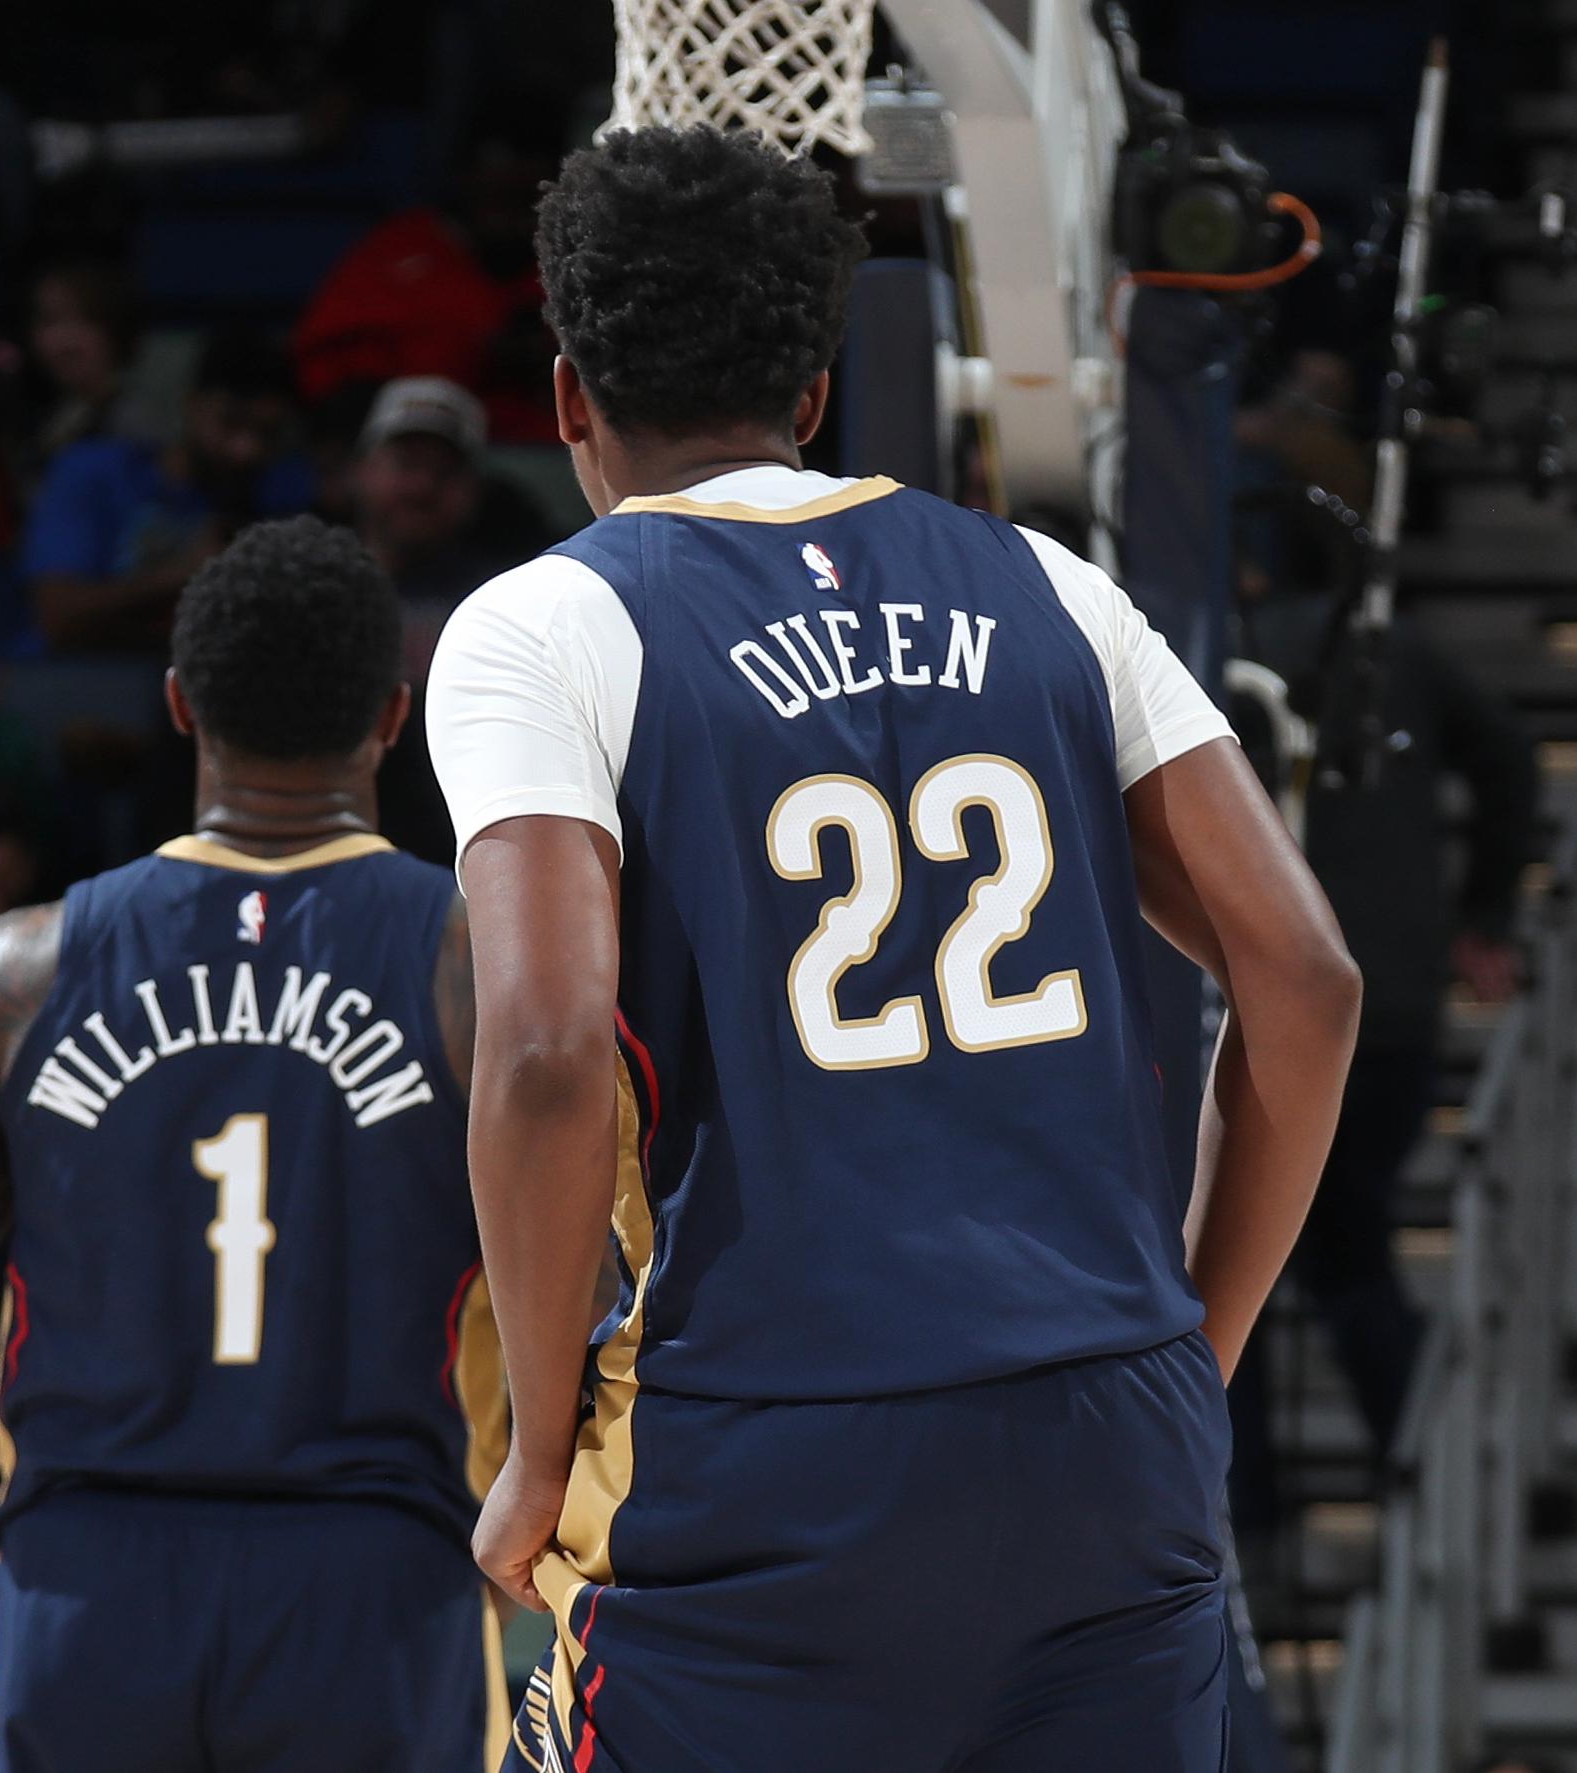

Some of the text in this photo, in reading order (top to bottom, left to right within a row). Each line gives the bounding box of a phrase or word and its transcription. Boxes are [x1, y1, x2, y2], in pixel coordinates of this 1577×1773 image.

[728, 601, 998, 720] QUEEN
[764, 751, 1089, 1072] 22
[26, 961, 435, 1130] WILLIAMSON
[192, 1112, 277, 1366] 1
